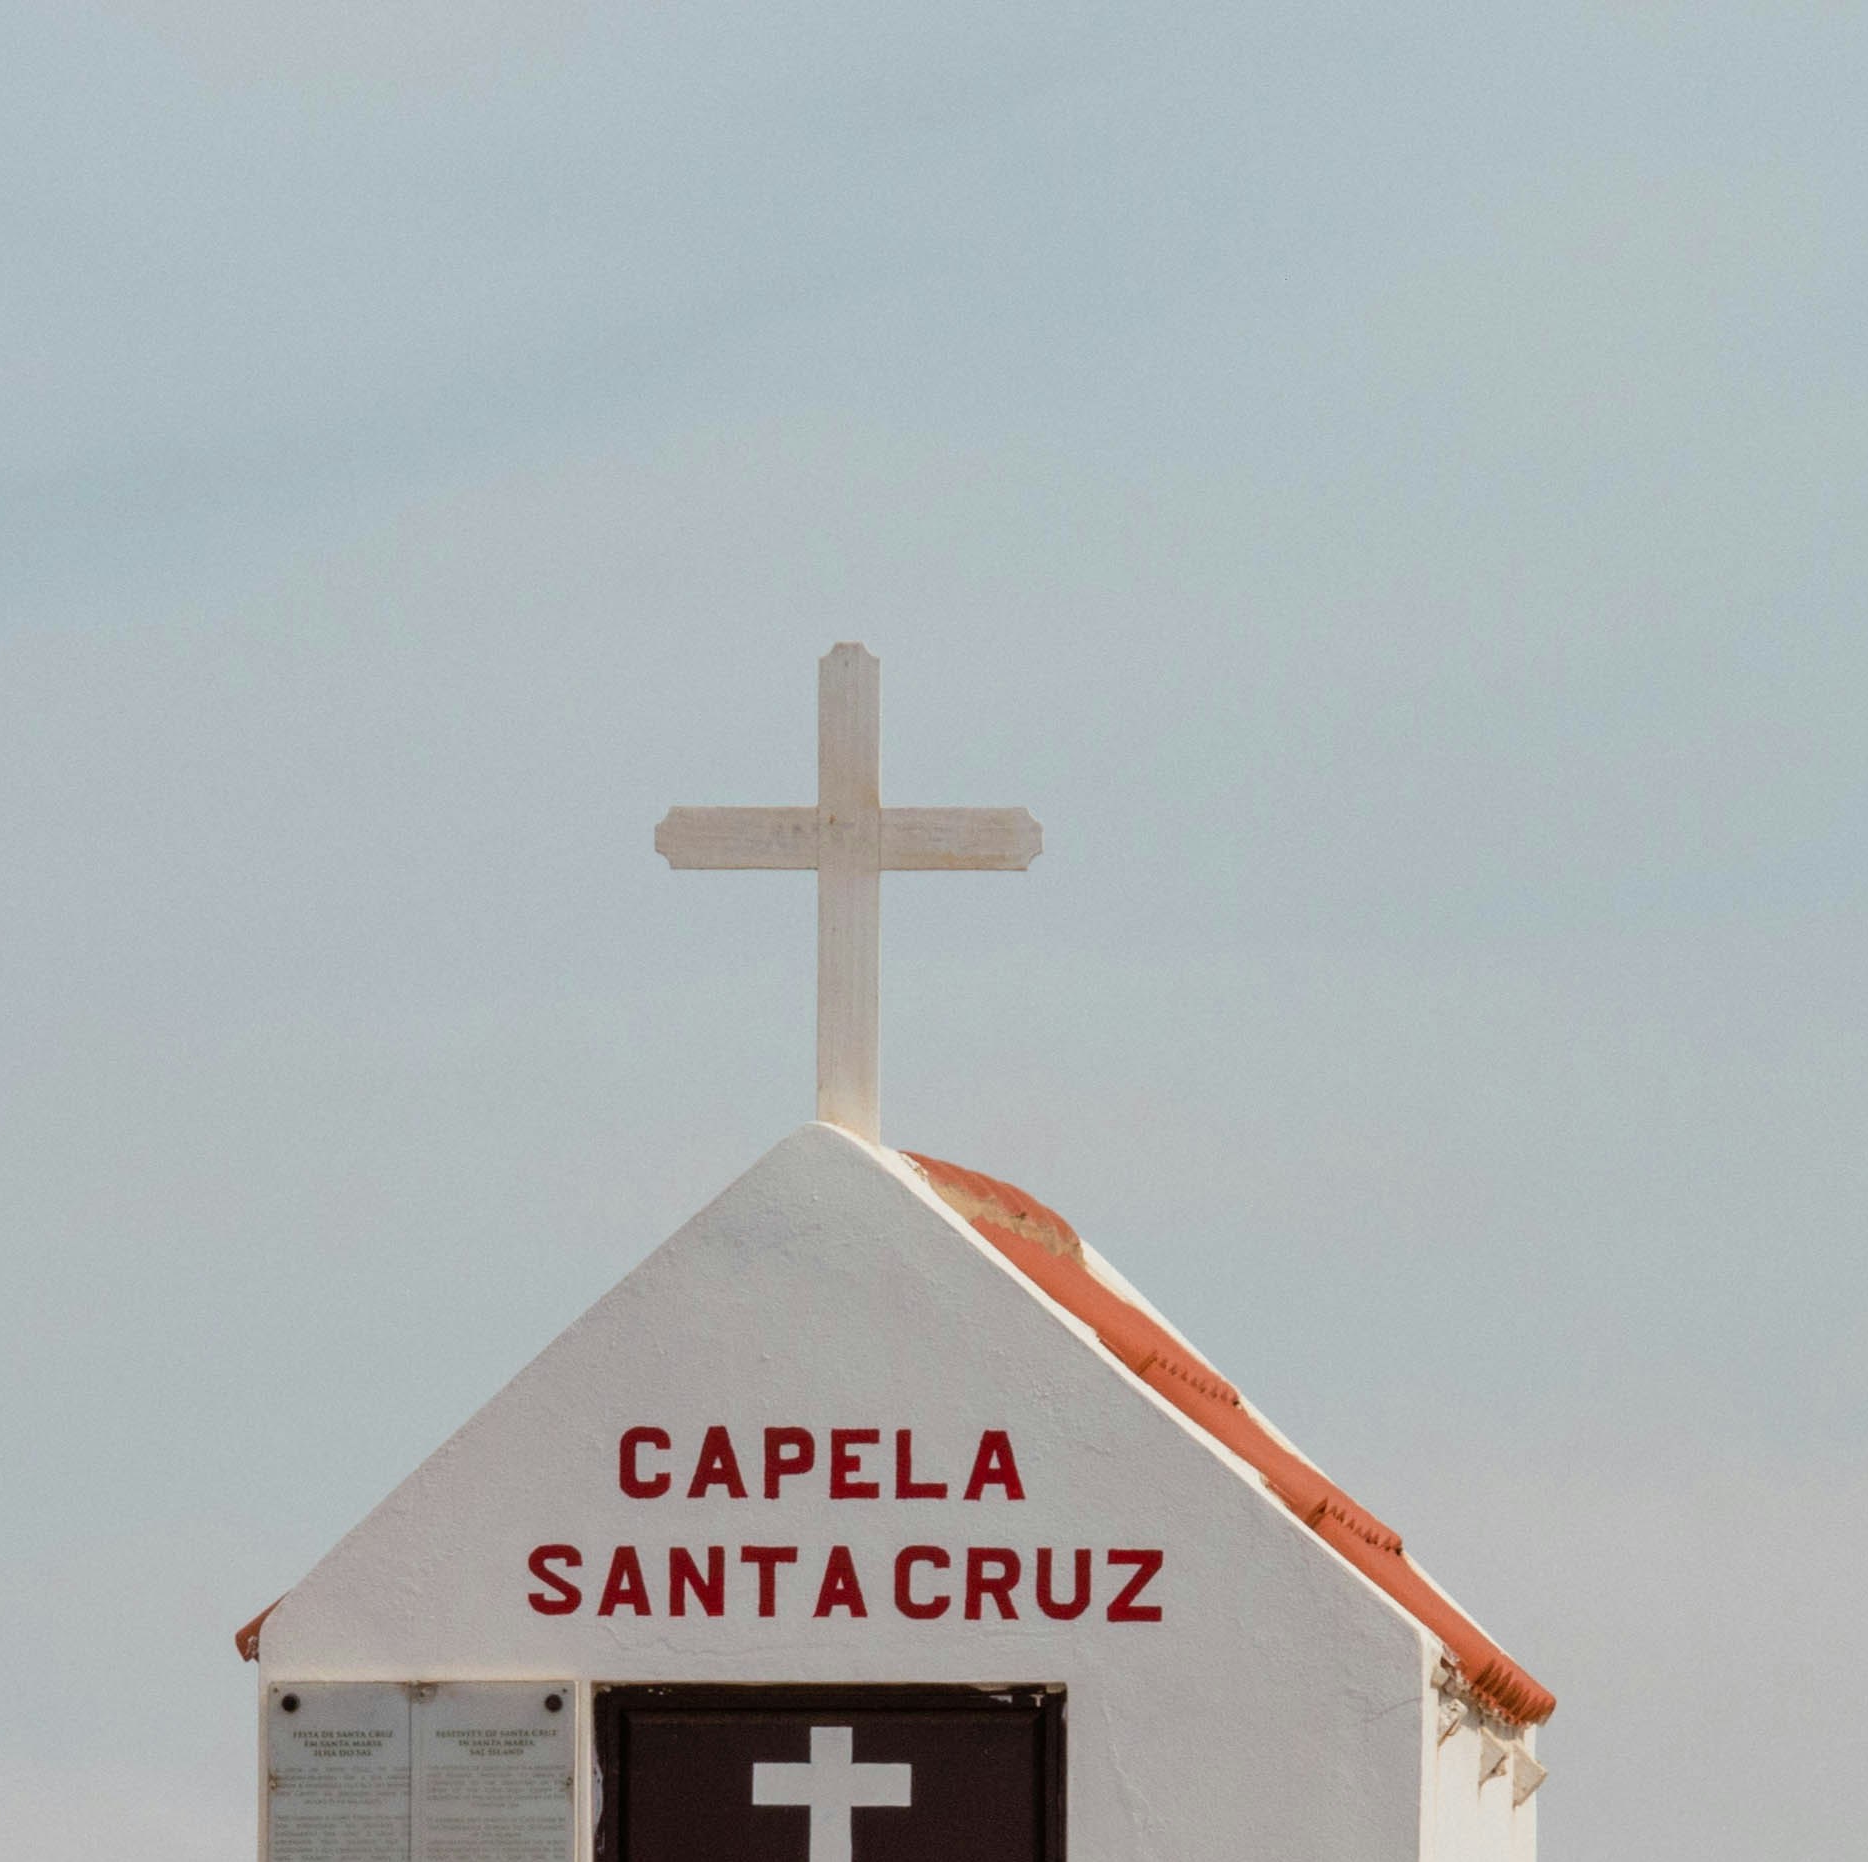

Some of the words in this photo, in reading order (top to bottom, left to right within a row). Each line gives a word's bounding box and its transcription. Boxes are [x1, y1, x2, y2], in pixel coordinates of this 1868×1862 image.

[619, 1426, 1025, 1501] CAPELA
[336, 1730, 366, 1739] SANTA
[368, 1730, 394, 1739] CRUZ
[500, 1729, 530, 1738] SANTA
[531, 1729, 558, 1738] CRUZ
[320, 1740, 349, 1748] SANTA
[352, 1740, 383, 1748] MARIA
[472, 1739, 502, 1747] SANTA
[504, 1739, 537, 1747] MARIA
